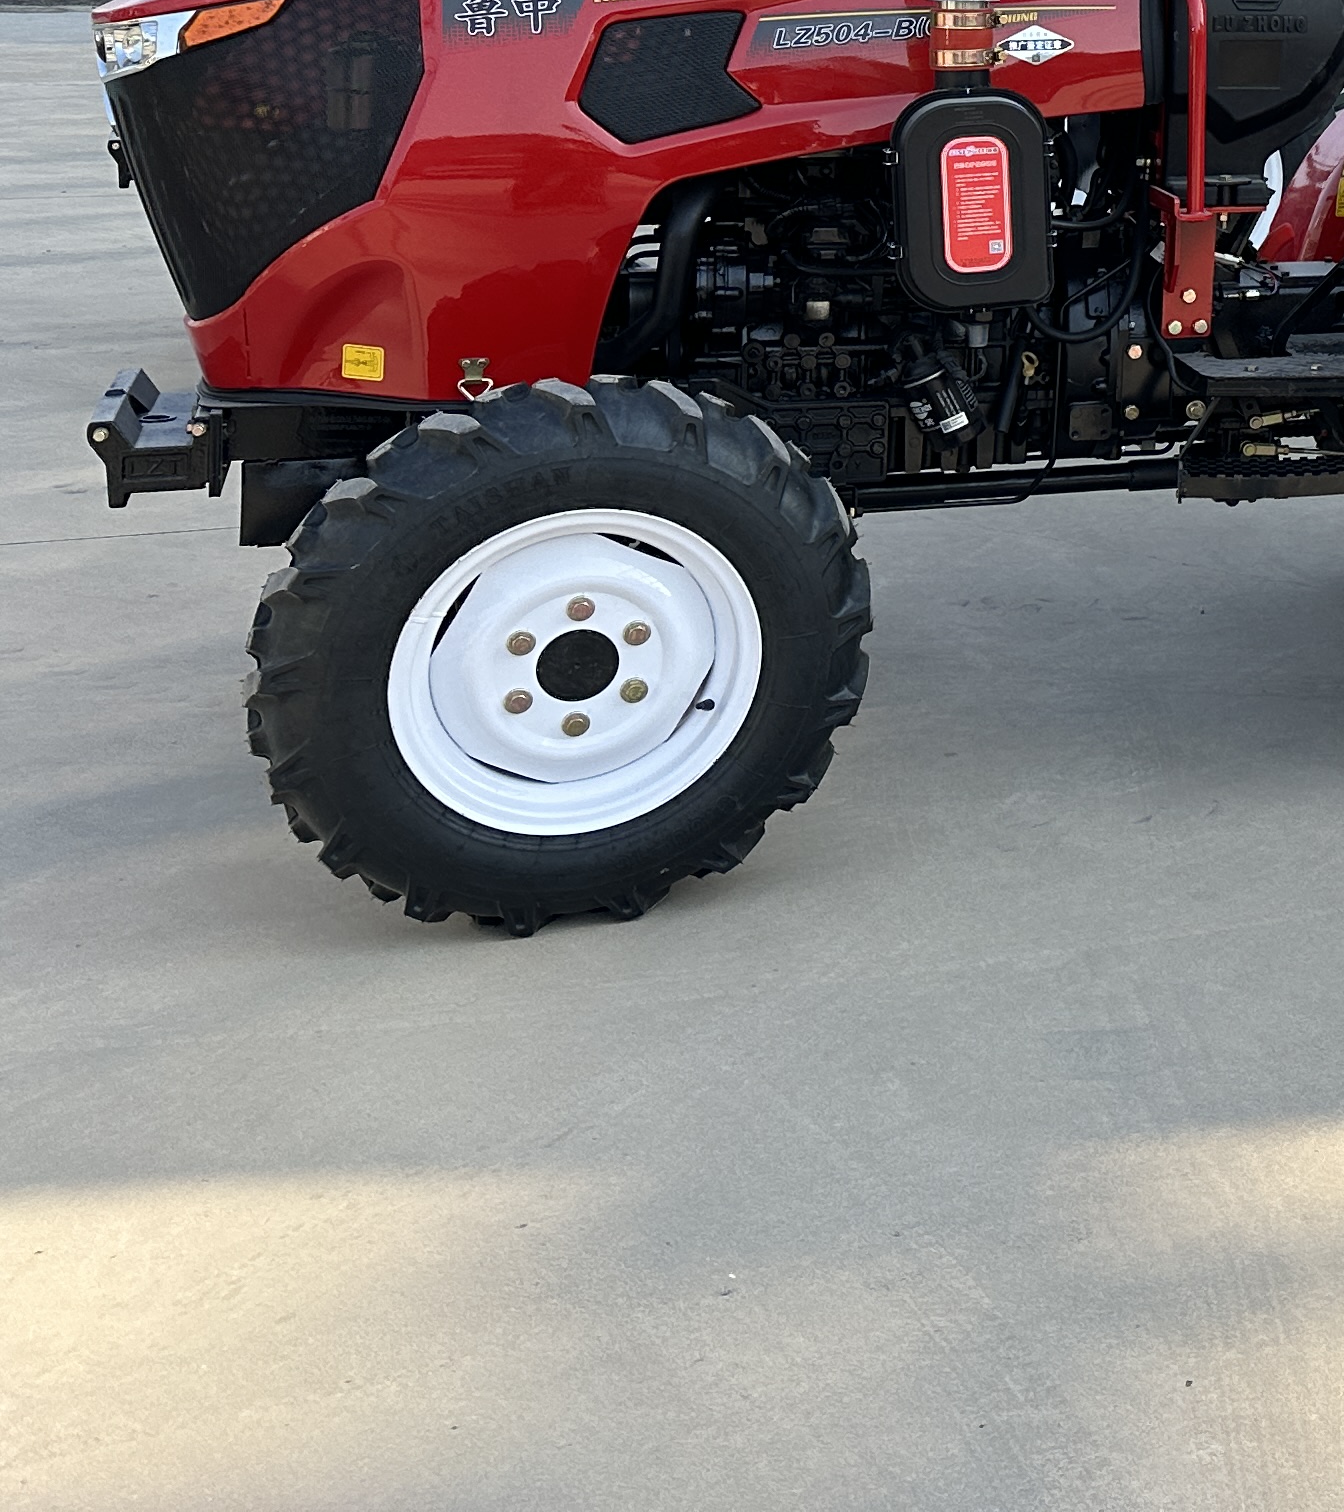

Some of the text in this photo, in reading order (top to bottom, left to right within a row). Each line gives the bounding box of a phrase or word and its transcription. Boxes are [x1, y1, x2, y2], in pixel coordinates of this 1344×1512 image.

[1212, 15, 1308, 33] LU ZHONG
[429, 465, 573, 534] TAISHAN
